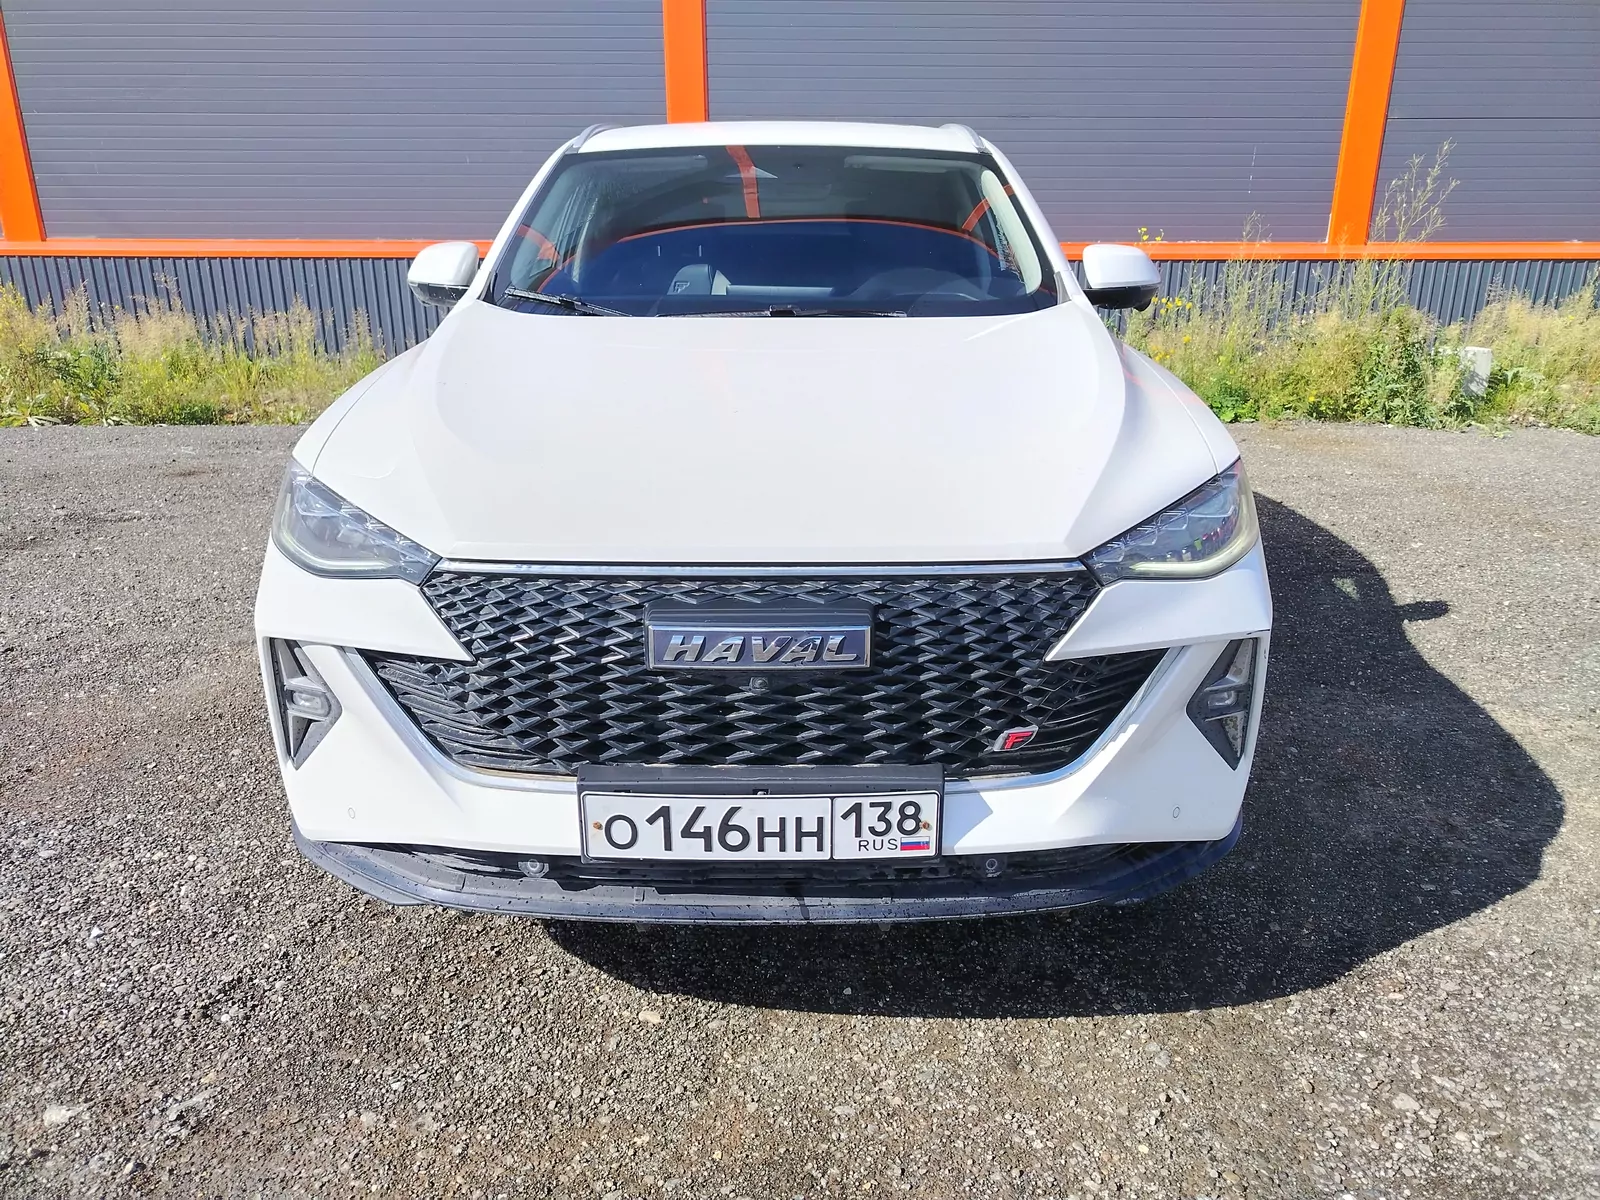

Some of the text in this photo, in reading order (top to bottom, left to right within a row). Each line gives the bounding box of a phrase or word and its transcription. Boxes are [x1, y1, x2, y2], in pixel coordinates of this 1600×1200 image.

[662, 635, 859, 663] HAVAL
[1004, 731, 1034, 750] F
[839, 800, 922, 838] 138
[858, 838, 898, 852] RUS
